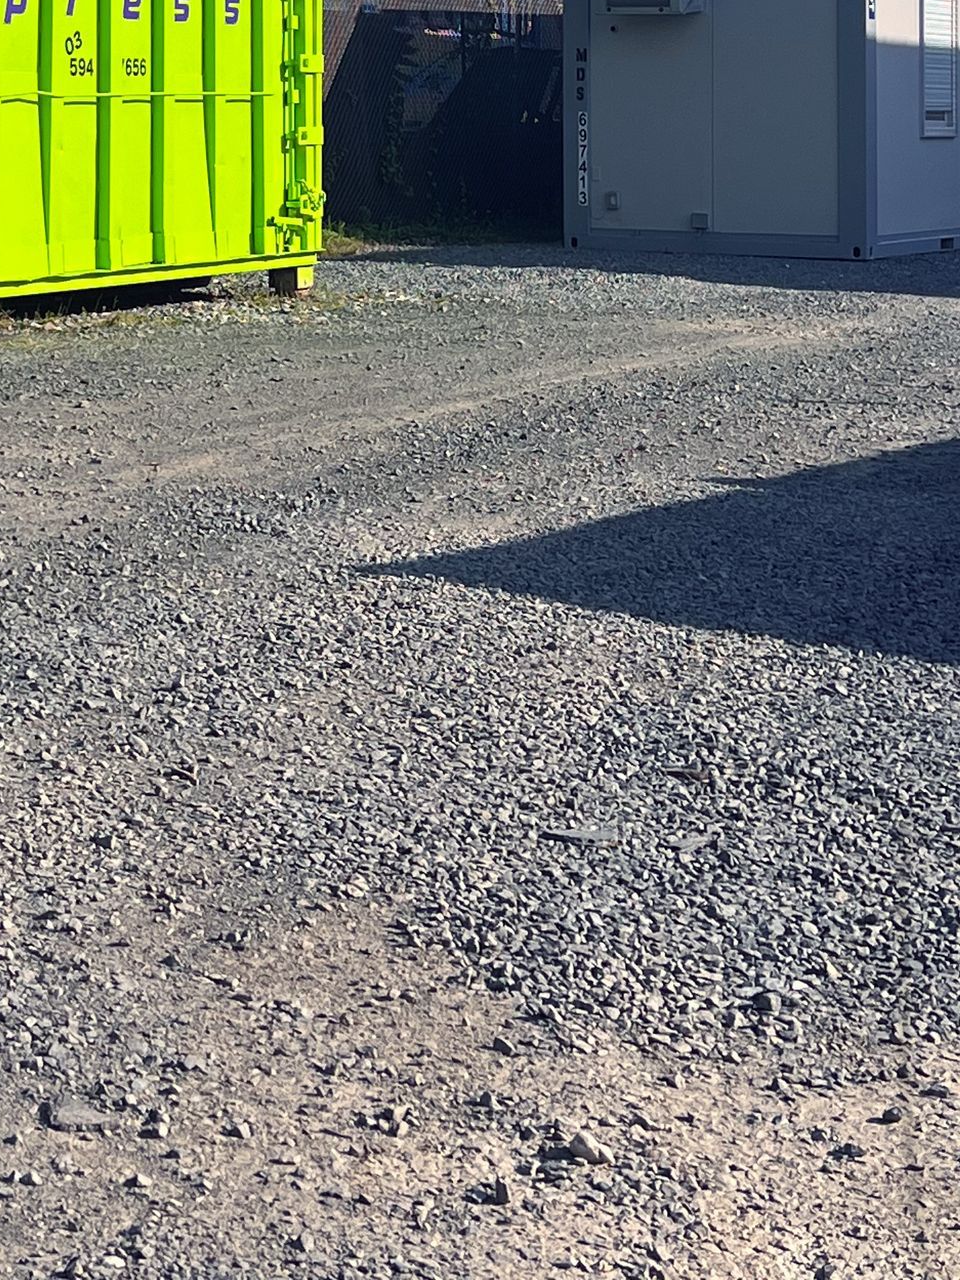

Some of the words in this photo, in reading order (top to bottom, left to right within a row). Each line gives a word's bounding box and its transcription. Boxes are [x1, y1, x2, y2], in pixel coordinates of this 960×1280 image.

[121, 57, 147, 77] 656
[575, 47, 588, 101] MDS
[578, 112, 588, 205] 697413
